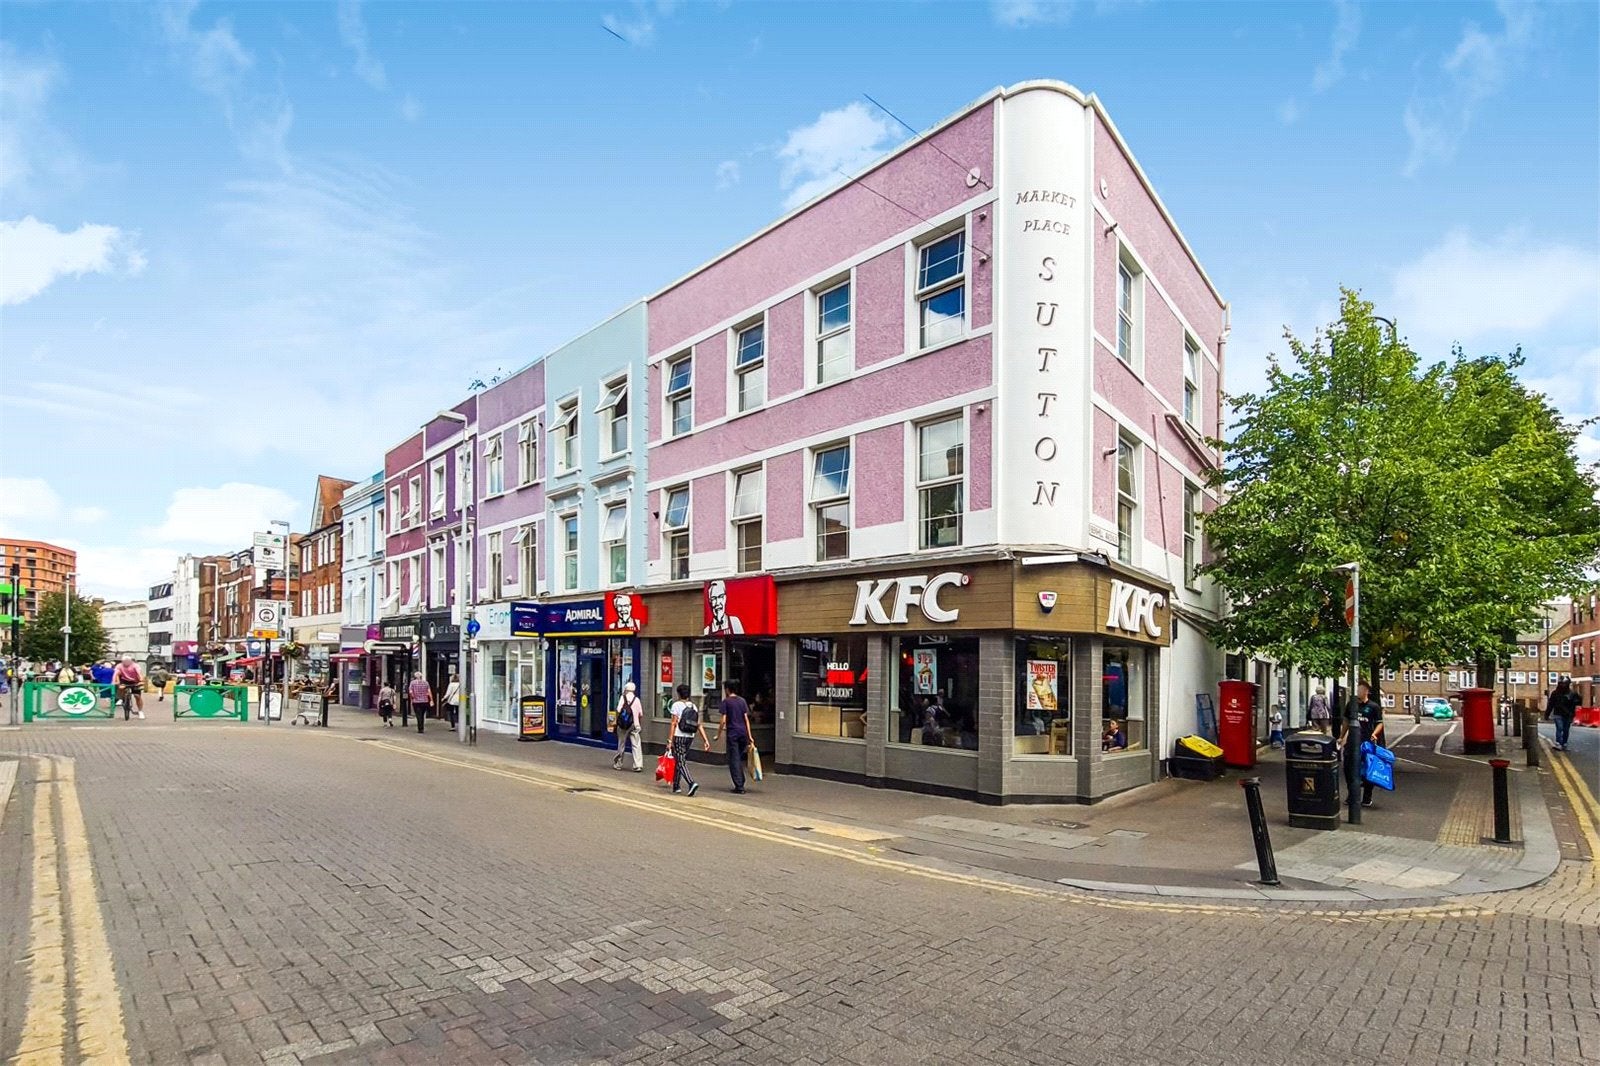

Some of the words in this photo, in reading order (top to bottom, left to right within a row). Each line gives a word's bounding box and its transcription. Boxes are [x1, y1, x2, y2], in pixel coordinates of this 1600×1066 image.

[1016, 190, 1076, 208] MARKET
[1023, 219, 1071, 235] PLACE
[1032, 256, 1060, 507] SUTTON
[848, 571, 963, 625] KFC
[564, 607, 603, 622] ADMIRAL
[1106, 578, 1163, 637] KFC
[827, 662, 849, 670] HELLO
[1031, 664, 1056, 673] TWISTER
